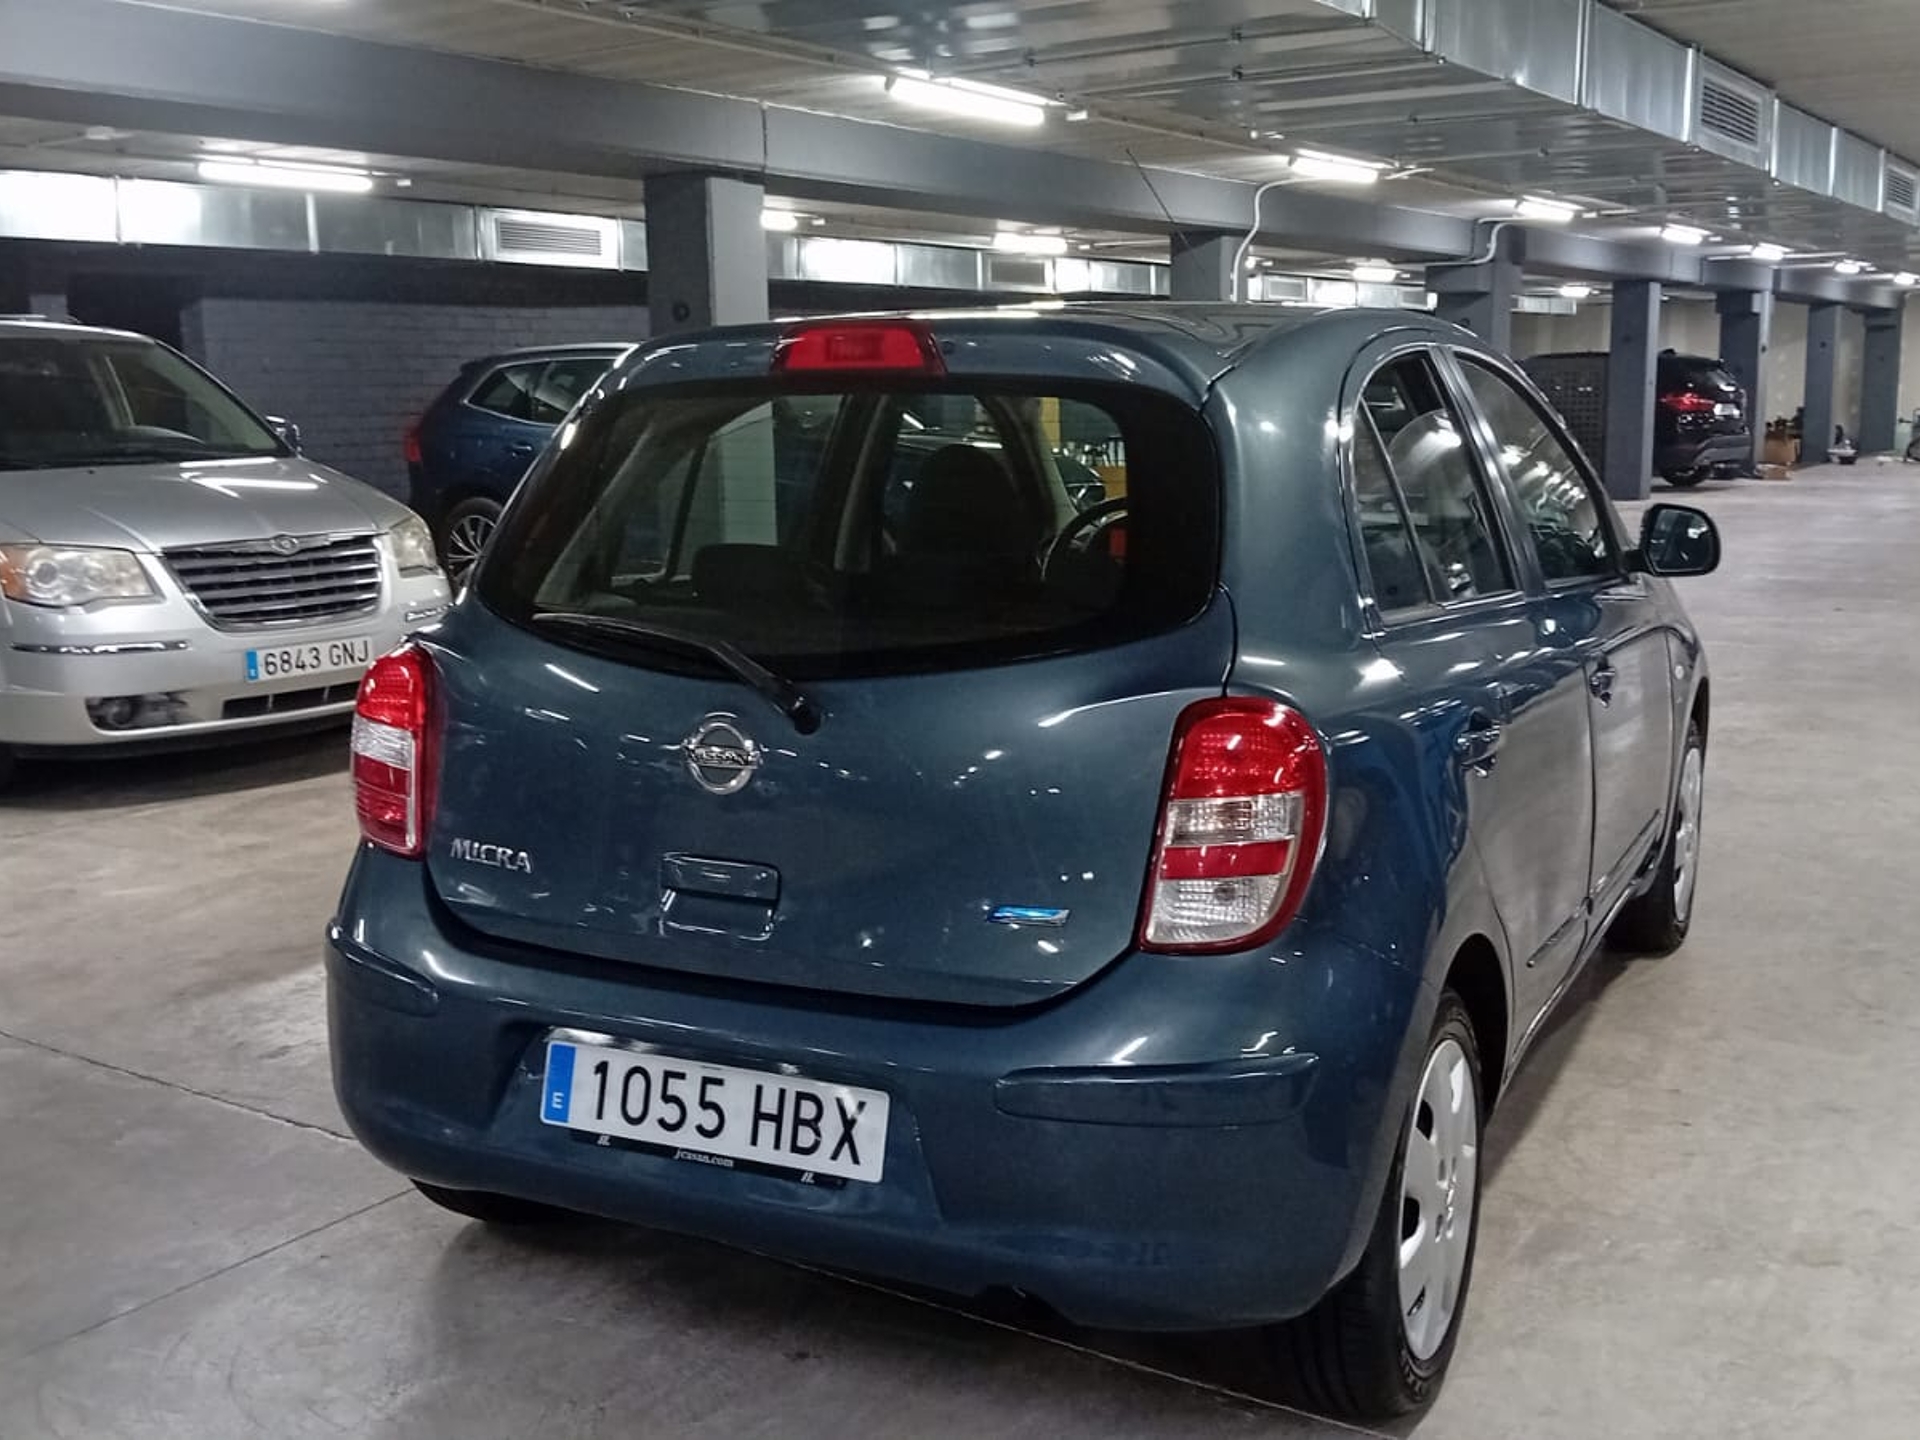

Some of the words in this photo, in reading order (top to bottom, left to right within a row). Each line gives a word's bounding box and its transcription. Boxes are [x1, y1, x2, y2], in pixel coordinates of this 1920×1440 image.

[264, 646, 321, 676] 6843
[329, 640, 369, 666] GNJ
[552, 1092, 563, 1109] E
[593, 1060, 726, 1139] 1055
[750, 1084, 867, 1166] HBX
